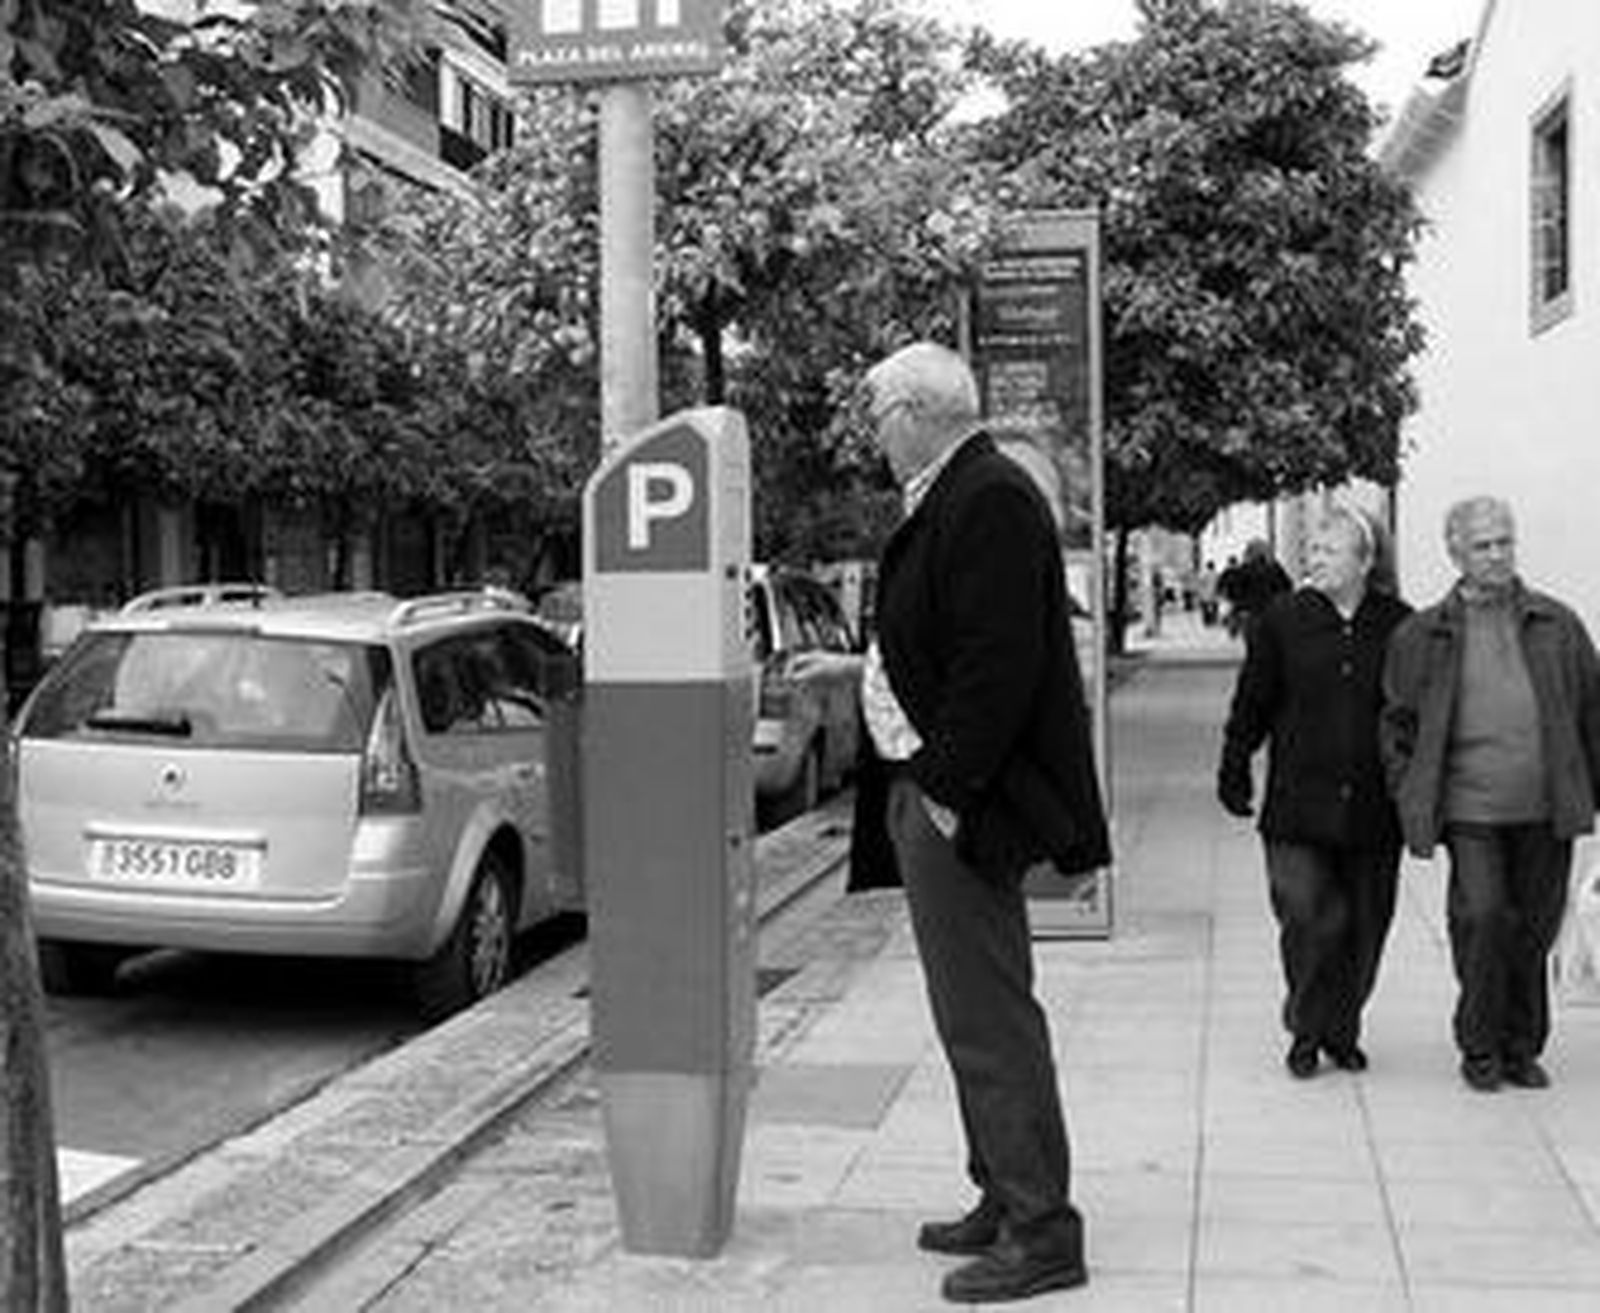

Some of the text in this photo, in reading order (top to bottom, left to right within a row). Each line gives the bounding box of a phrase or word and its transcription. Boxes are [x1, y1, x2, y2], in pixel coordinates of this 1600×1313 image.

[517, 47, 580, 65] PLAZA
[585, 45, 624, 62] DEL
[628, 463, 694, 549] P
